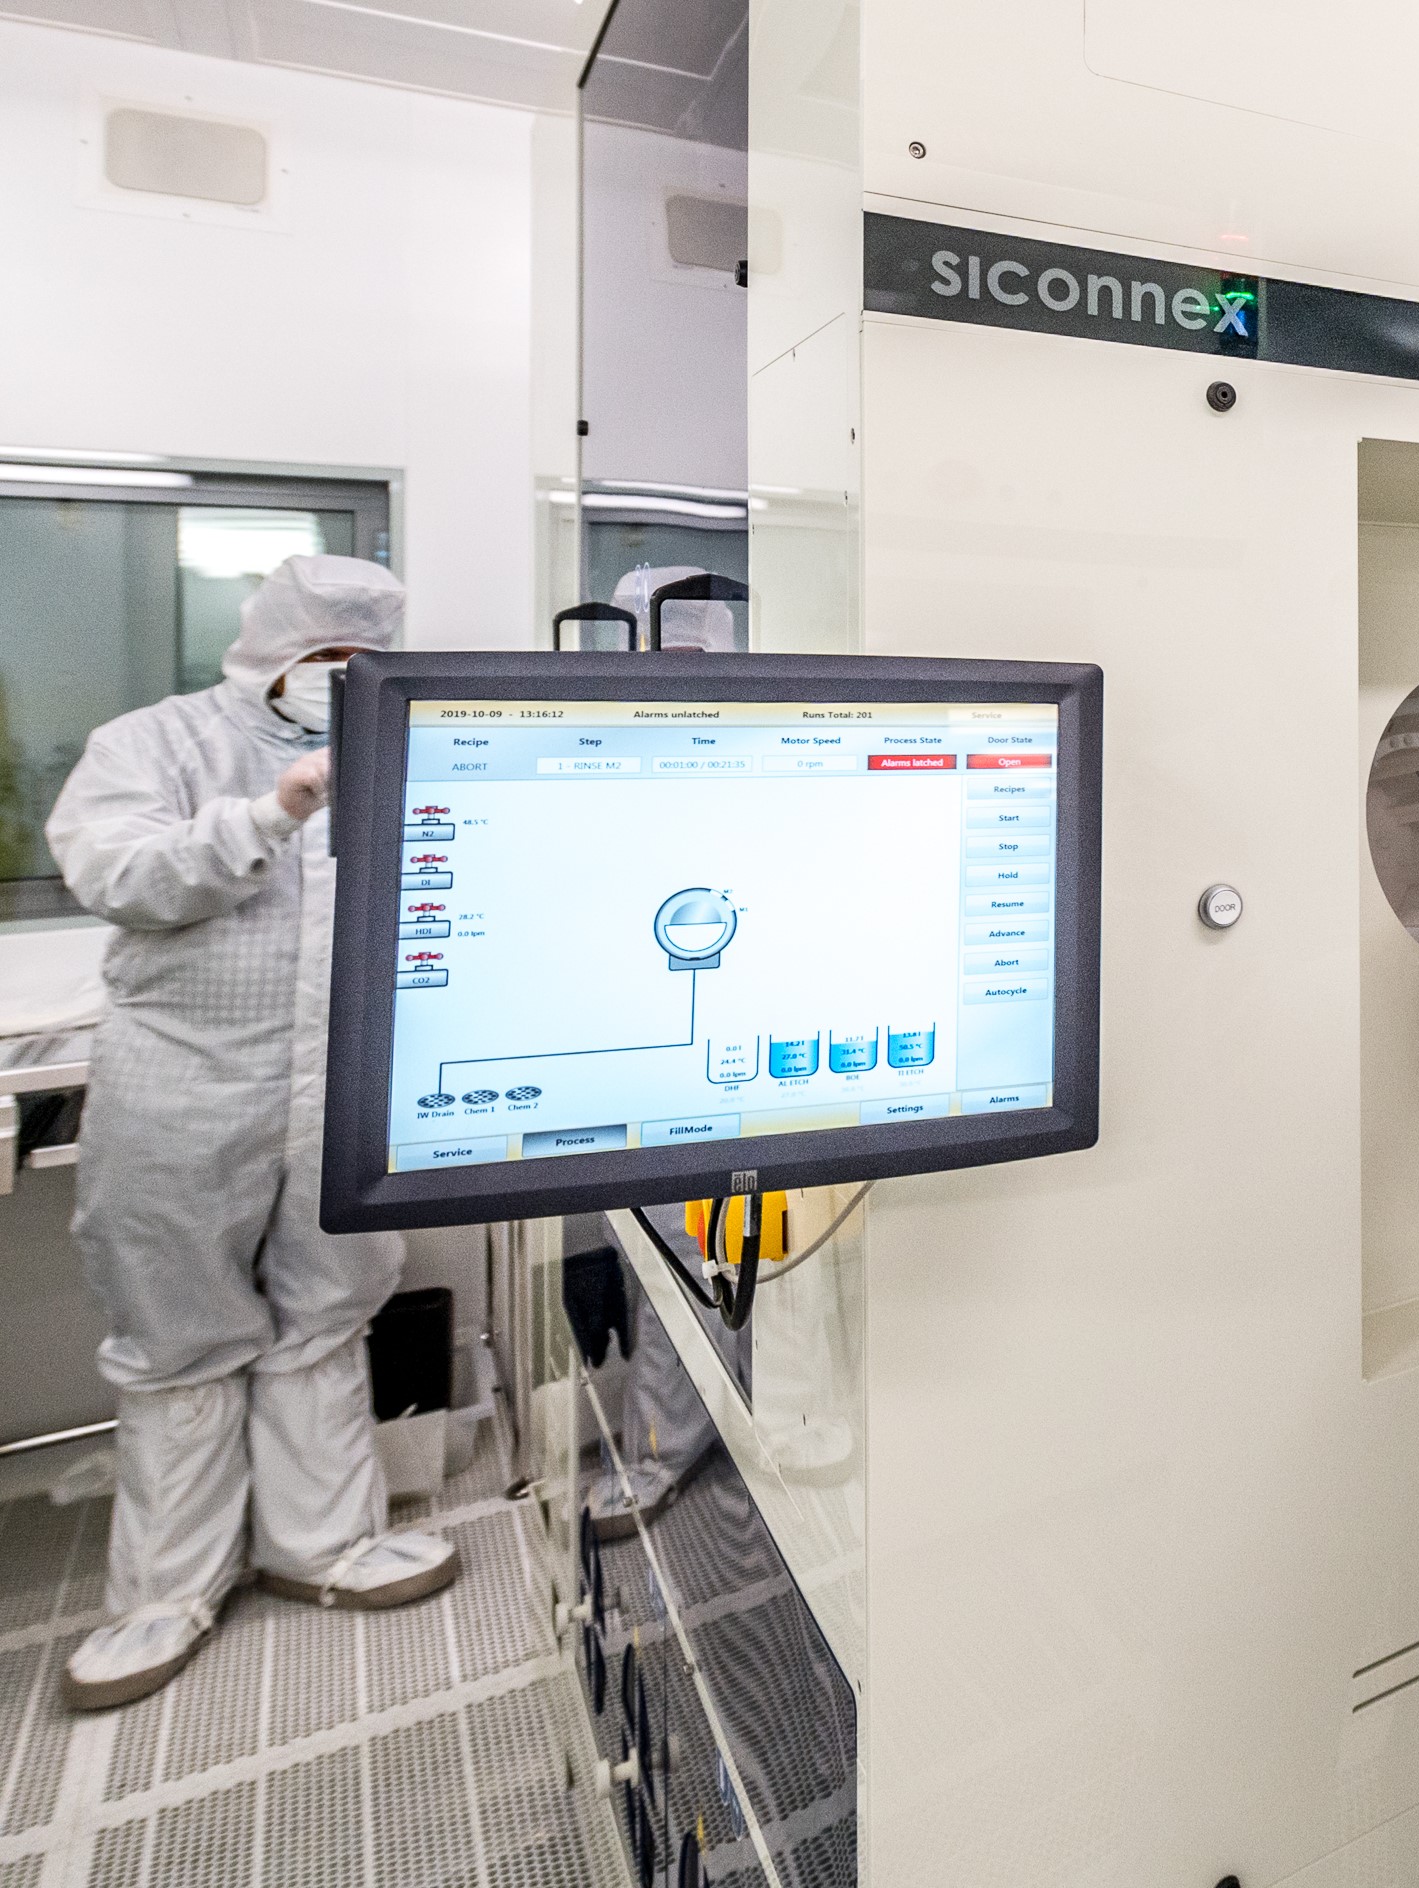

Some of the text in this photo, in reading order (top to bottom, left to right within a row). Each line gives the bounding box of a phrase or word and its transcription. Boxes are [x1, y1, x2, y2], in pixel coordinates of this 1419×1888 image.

[440, 710, 503, 718] 2019-10-09
[519, 710, 564, 718] 13:16:12
[633, 710, 720, 719] Alarms unlatched
[802, 711, 873, 719] Runs Total: 201
[971, 711, 1002, 720] Service
[453, 738, 489, 748] Recipe
[579, 738, 602, 747] Step
[691, 737, 716, 745] Time
[781, 737, 841, 746] Motor Speed
[919, 736, 942, 744] State
[987, 736, 1033, 744] Door State
[451, 763, 488, 771] ABORT
[558, 762, 562, 770] 1
[573, 762, 602, 770] RINSE
[605, 761, 622, 770] M2
[659, 761, 698, 769] 00:01:00
[707, 760, 746, 769] 00:21:35
[797, 760, 824, 769] 0 rpm
[880, 757, 944, 768] Alarms latched
[998, 757, 1022, 768] Open
[993, 785, 1026, 795] Recipes
[998, 814, 1020, 822] Start
[421, 829, 435, 838] N2
[998, 842, 1019, 851] Stop
[998, 871, 1019, 880] Hold
[421, 879, 431, 887] DI
[991, 900, 1025, 909] Resume
[1214, 903, 1237, 913] DOOR
[415, 928, 432, 936] HDI
[989, 929, 1026, 938] Advance
[994, 957, 1020, 967] Abort
[412, 976, 431, 986] CO2
[985, 986, 1028, 997] Autocycle
[989, 1094, 1020, 1104] Alarms
[464, 1107, 488, 1116] Chem
[507, 1103, 531, 1112] Chem
[886, 1104, 924, 1116] Settings
[431, 1110, 455, 1119] Drain
[669, 1124, 713, 1136] FillMode
[555, 1135, 595, 1146] Process
[432, 1148, 473, 1159] Service
